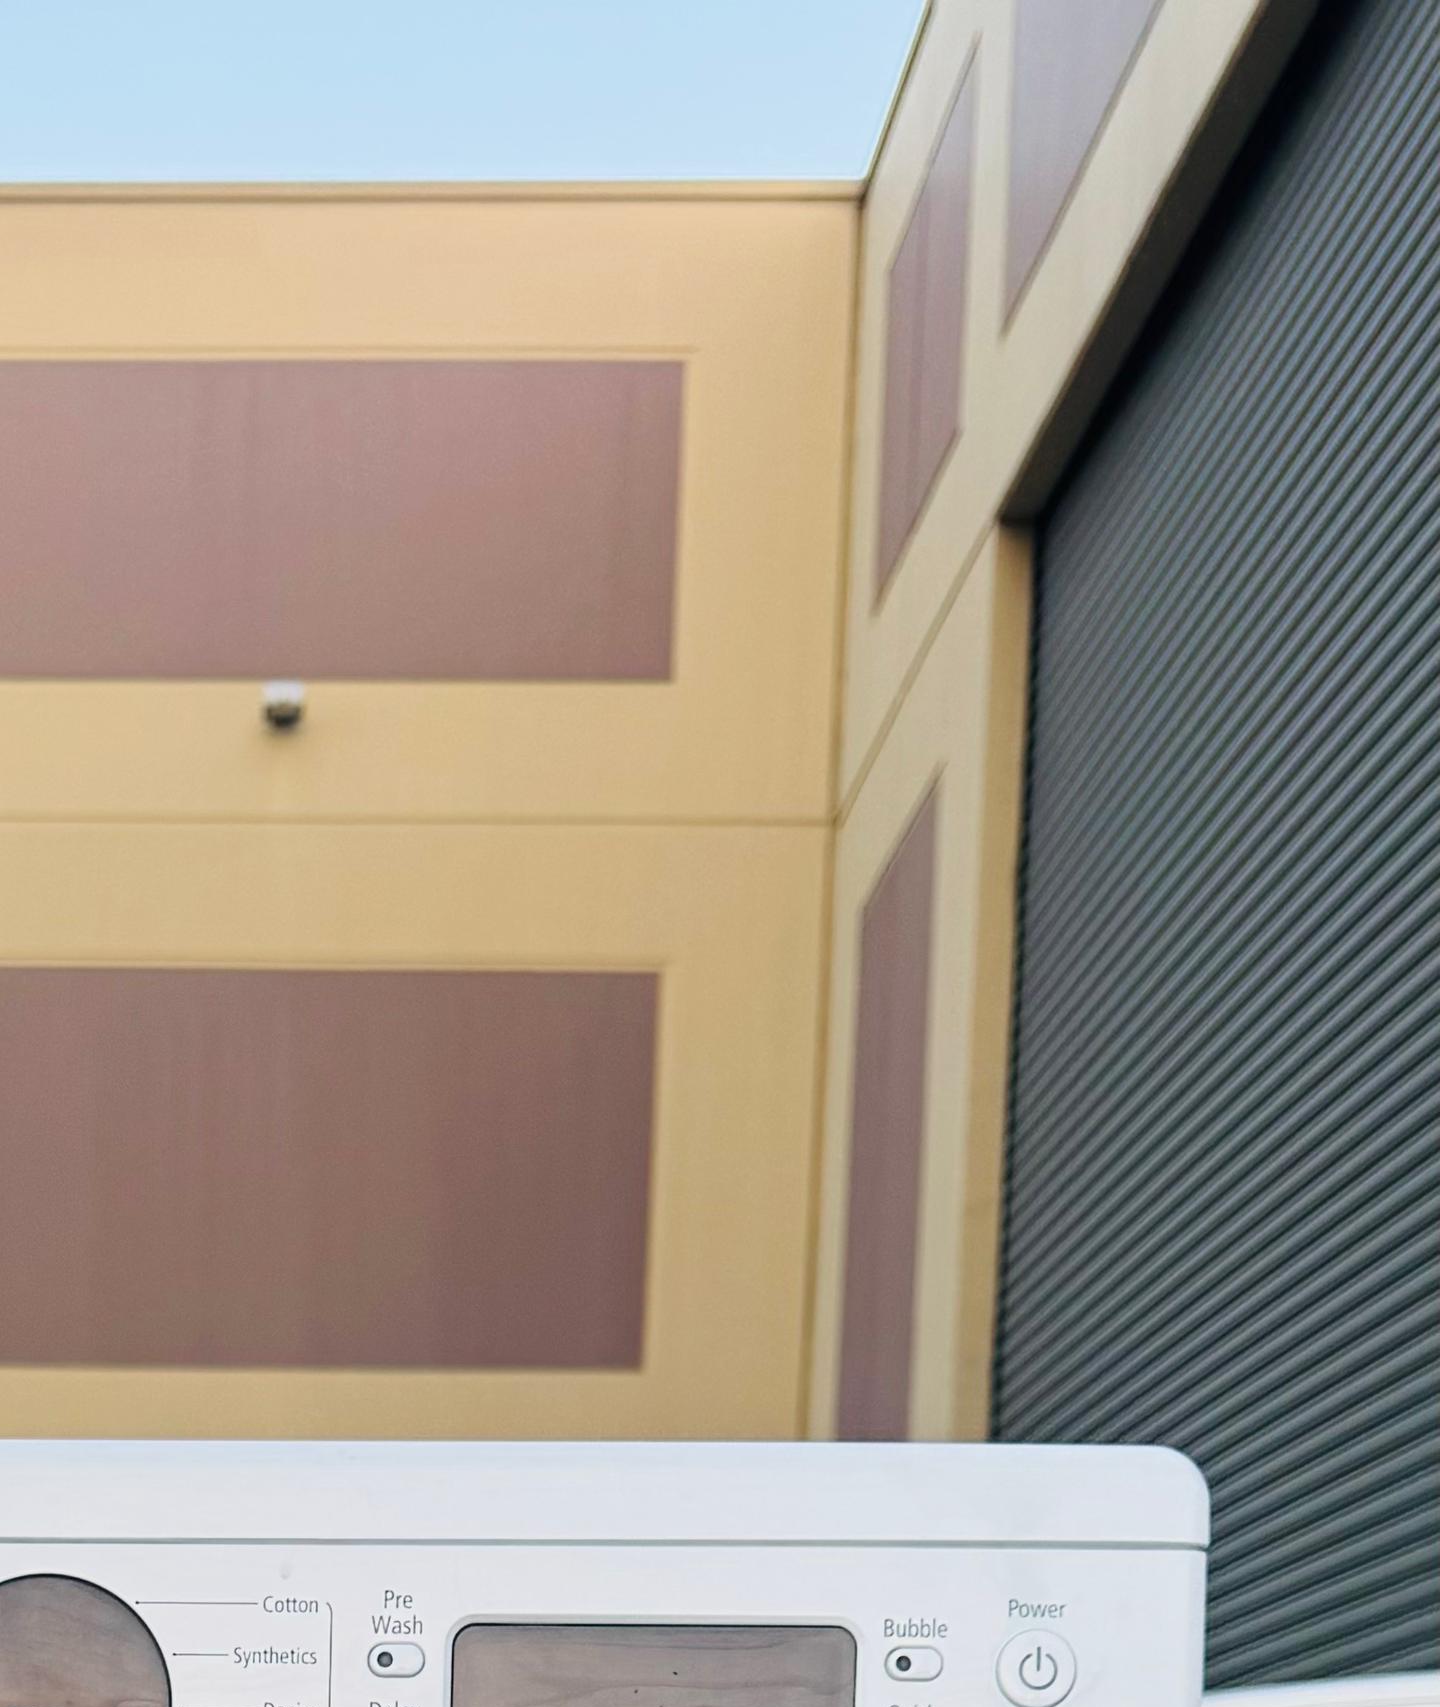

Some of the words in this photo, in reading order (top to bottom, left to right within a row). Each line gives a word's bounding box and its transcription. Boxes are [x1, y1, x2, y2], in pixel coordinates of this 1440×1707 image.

[262, 1595, 319, 1614] Cotton
[384, 1589, 413, 1609] Pre
[1008, 1598, 1066, 1619] Power
[371, 1614, 423, 1635] Wash
[883, 1617, 948, 1639] Bubble
[233, 1646, 318, 1669] Synthetics
